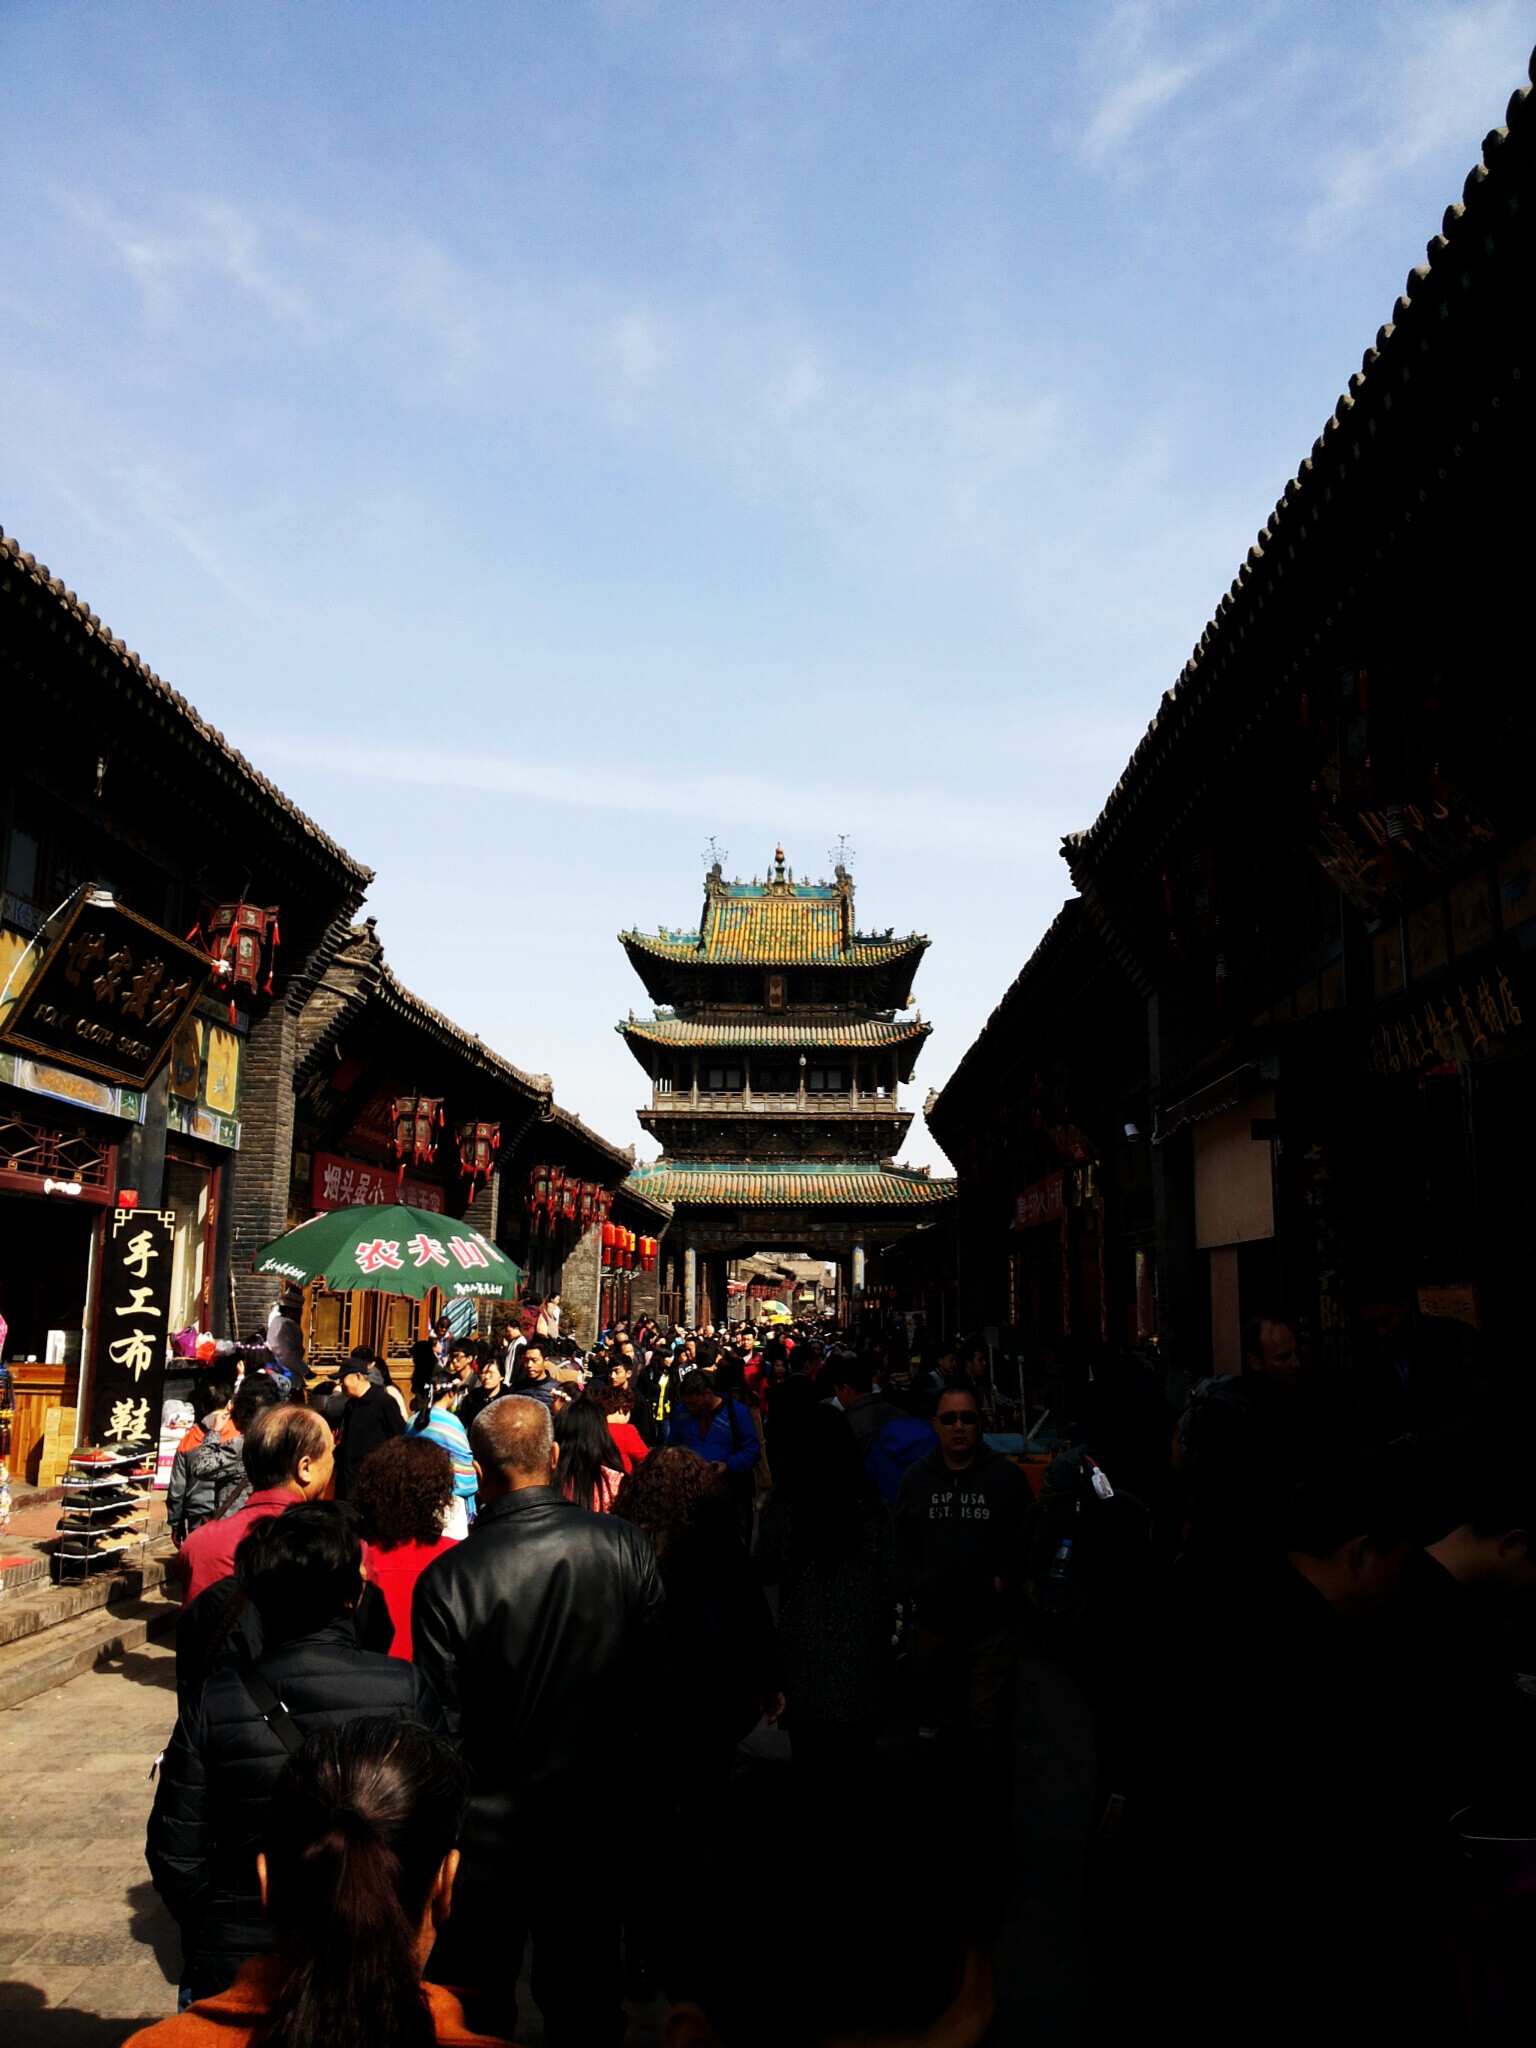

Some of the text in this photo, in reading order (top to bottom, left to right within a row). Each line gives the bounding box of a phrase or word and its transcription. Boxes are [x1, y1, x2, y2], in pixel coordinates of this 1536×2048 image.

[33, 1003, 151, 1060] FOLK CLOTH SHOES
[323, 1163, 384, 1204] 烟头虽小
[104, 1230, 161, 1440] 手工布鞋
[931, 1491, 985, 1504] GAP USA
